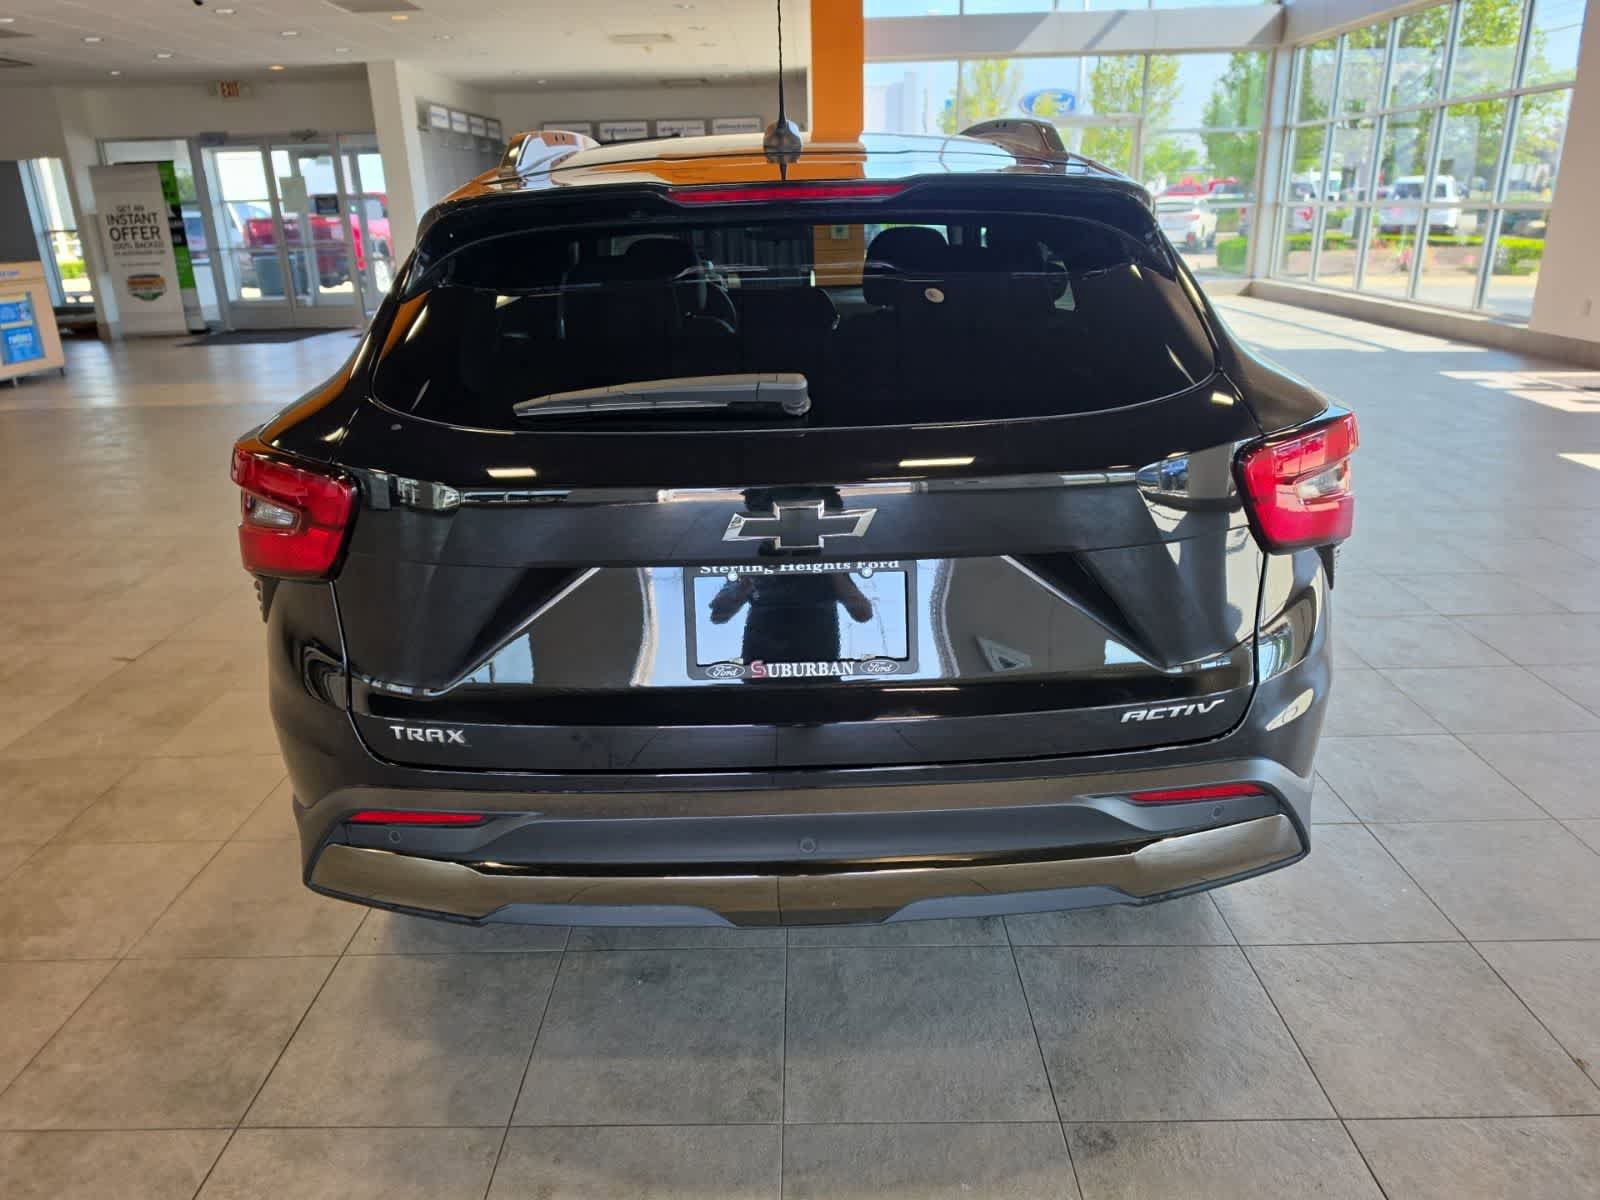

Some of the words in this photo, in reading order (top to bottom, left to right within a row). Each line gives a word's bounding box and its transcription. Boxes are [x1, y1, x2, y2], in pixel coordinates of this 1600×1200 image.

[106, 212, 158, 226] INSTANT
[109, 225, 161, 242] OFFER
[750, 660, 855, 679] SUBURBAN
[1121, 699, 1224, 723] ACTIV
[389, 725, 465, 744] TRAX
